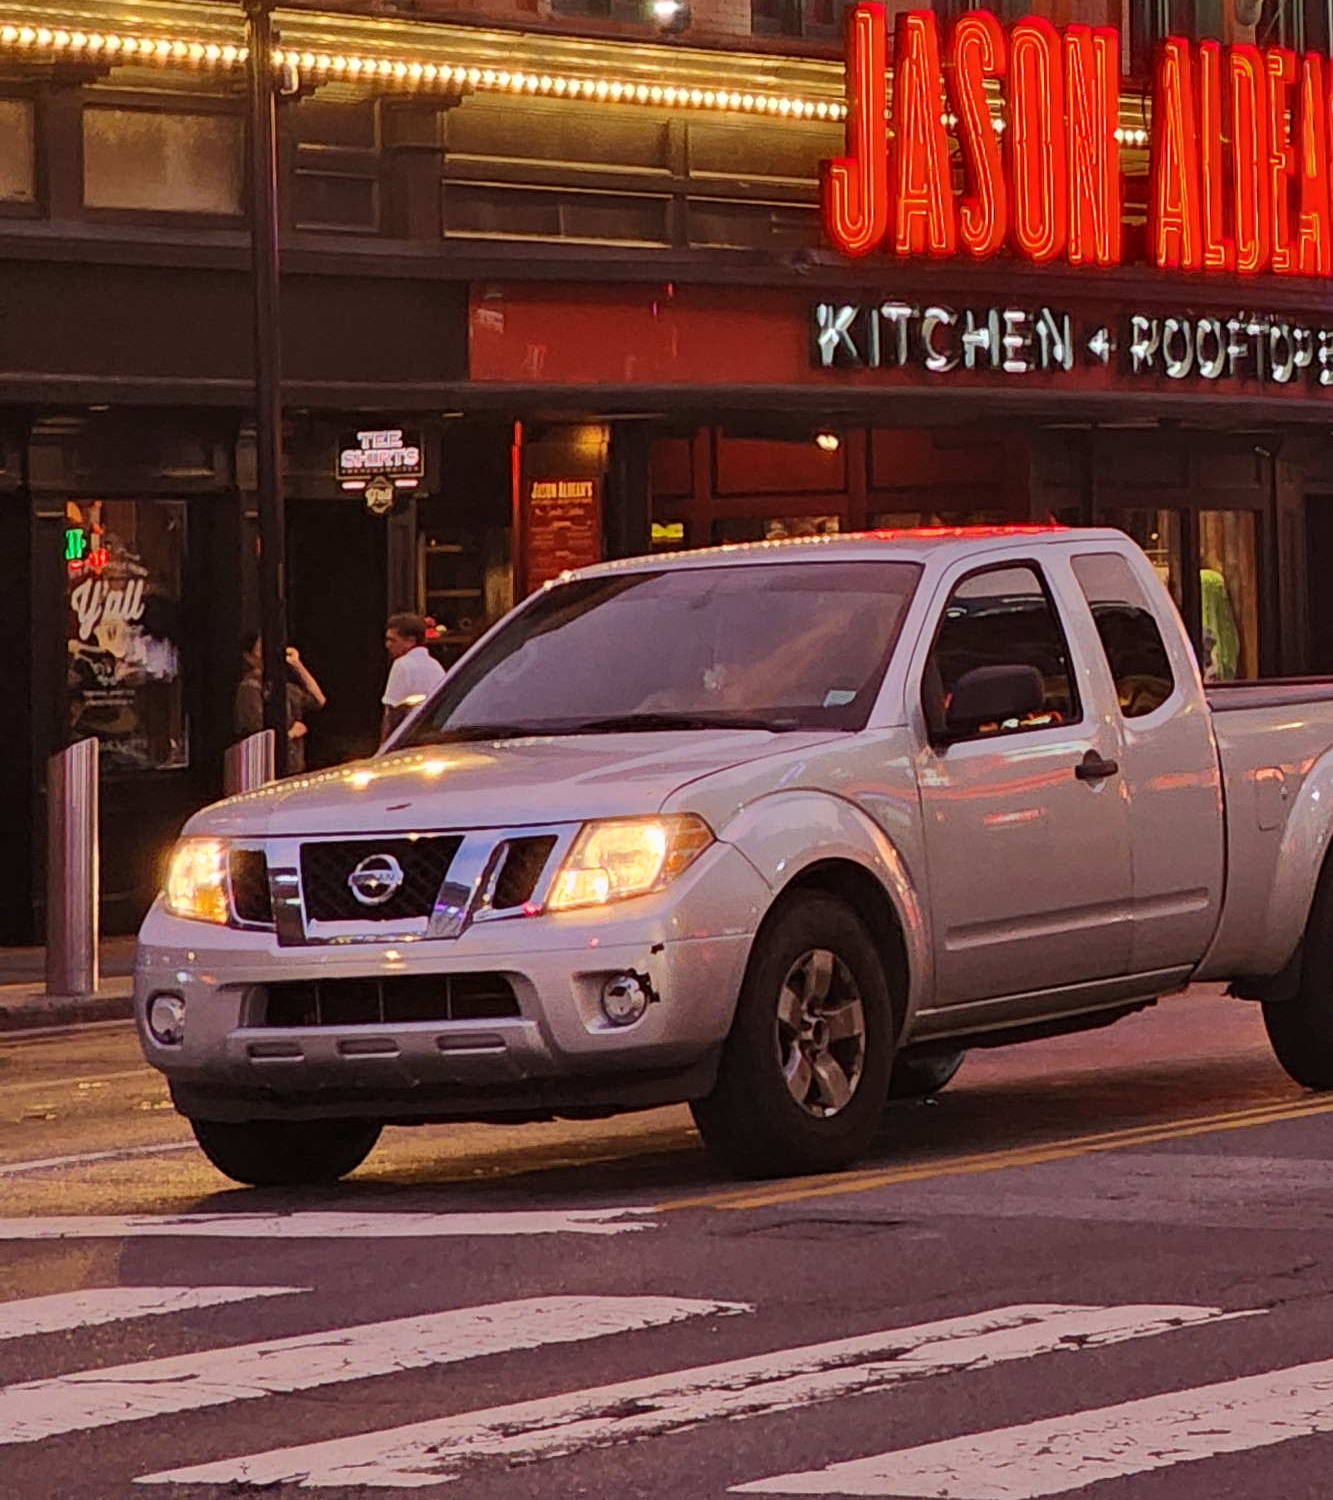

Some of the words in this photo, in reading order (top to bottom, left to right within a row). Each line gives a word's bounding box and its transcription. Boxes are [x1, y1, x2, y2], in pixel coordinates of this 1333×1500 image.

[826, 1, 1122, 259] JASON
[814, 301, 1076, 373] KITCHEN
[1129, 311, 1314, 384] ROOFTOP
[341, 446, 420, 468] SHIRTS
[357, 430, 404, 450] TEE
[71, 577, 146, 641] Y'all
